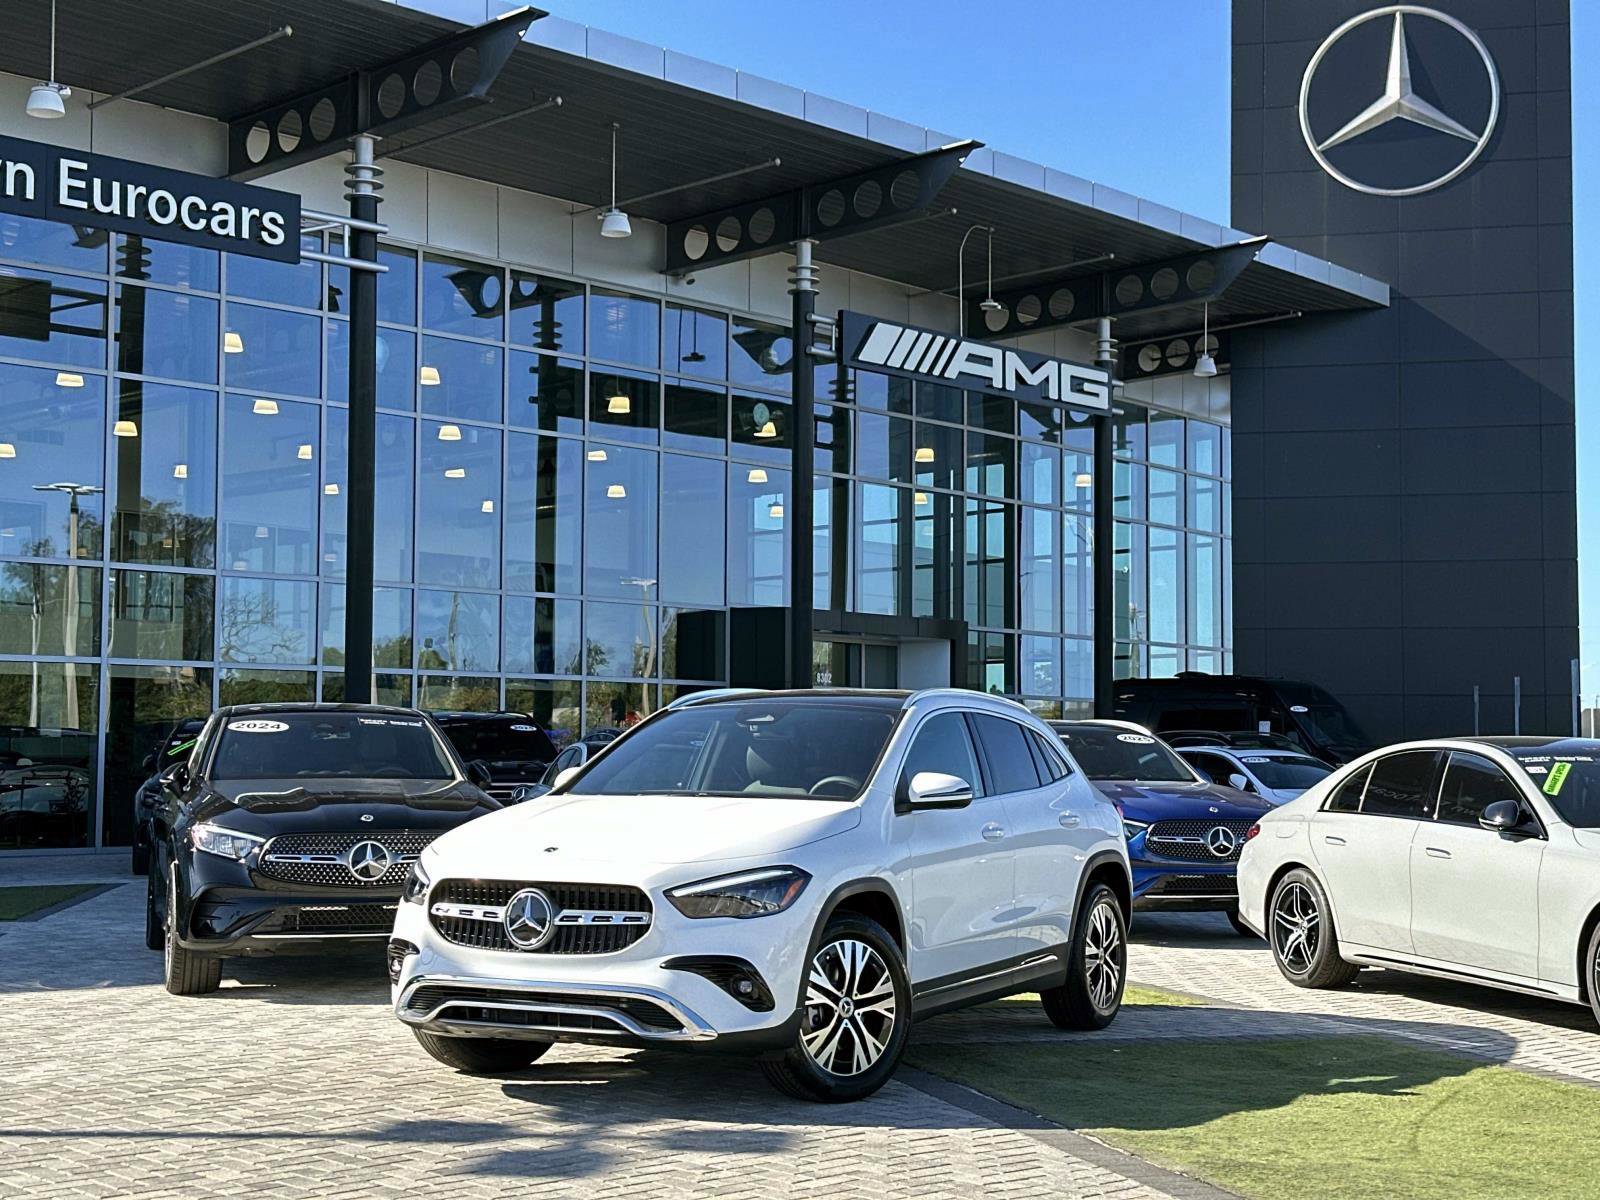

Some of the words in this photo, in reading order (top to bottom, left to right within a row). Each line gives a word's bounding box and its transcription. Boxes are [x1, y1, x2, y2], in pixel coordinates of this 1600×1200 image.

[0, 159, 35, 200] n
[59, 158, 286, 246] Eurocars
[944, 341, 1109, 410] AMG
[235, 722, 281, 730] 2024
